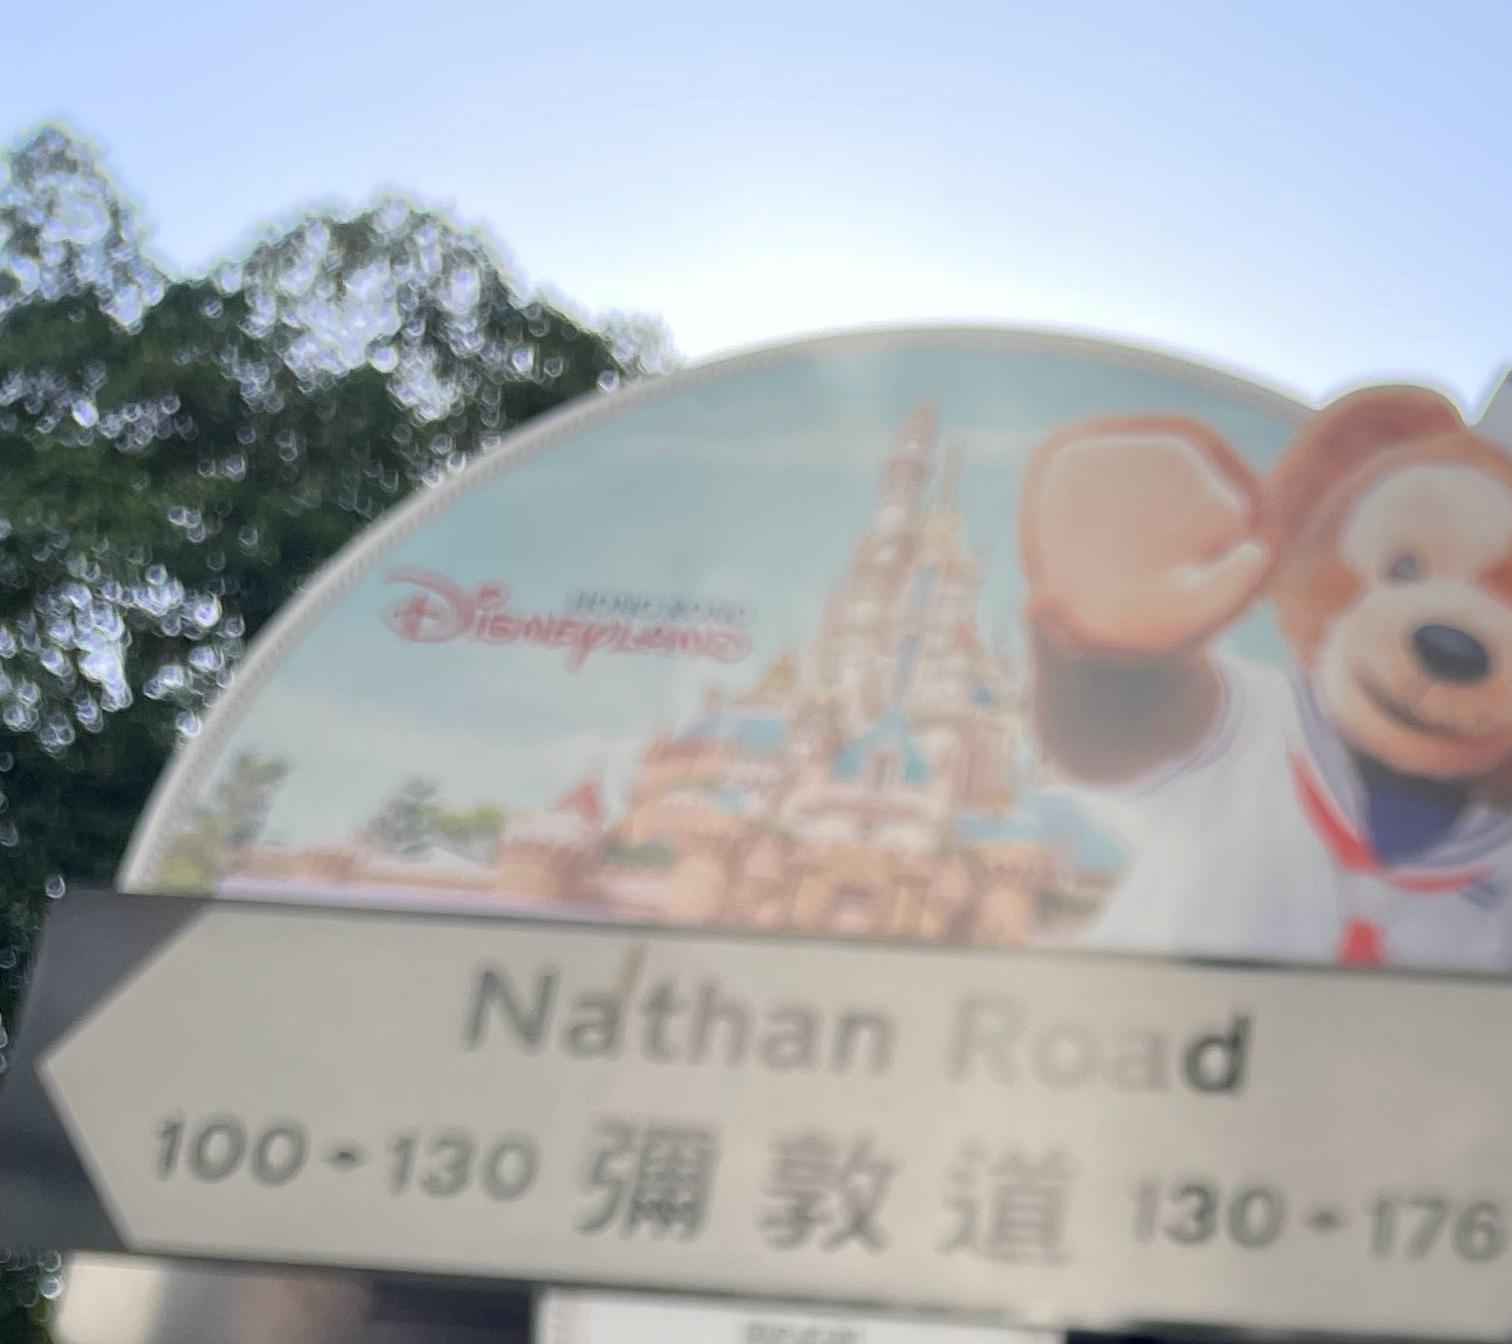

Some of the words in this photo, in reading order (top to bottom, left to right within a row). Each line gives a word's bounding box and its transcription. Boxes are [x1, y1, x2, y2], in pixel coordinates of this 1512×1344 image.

[464, 962, 896, 1074] Nathan
[946, 997, 1252, 1095] Road
[577, 1117, 1074, 1264] 彌敦道
